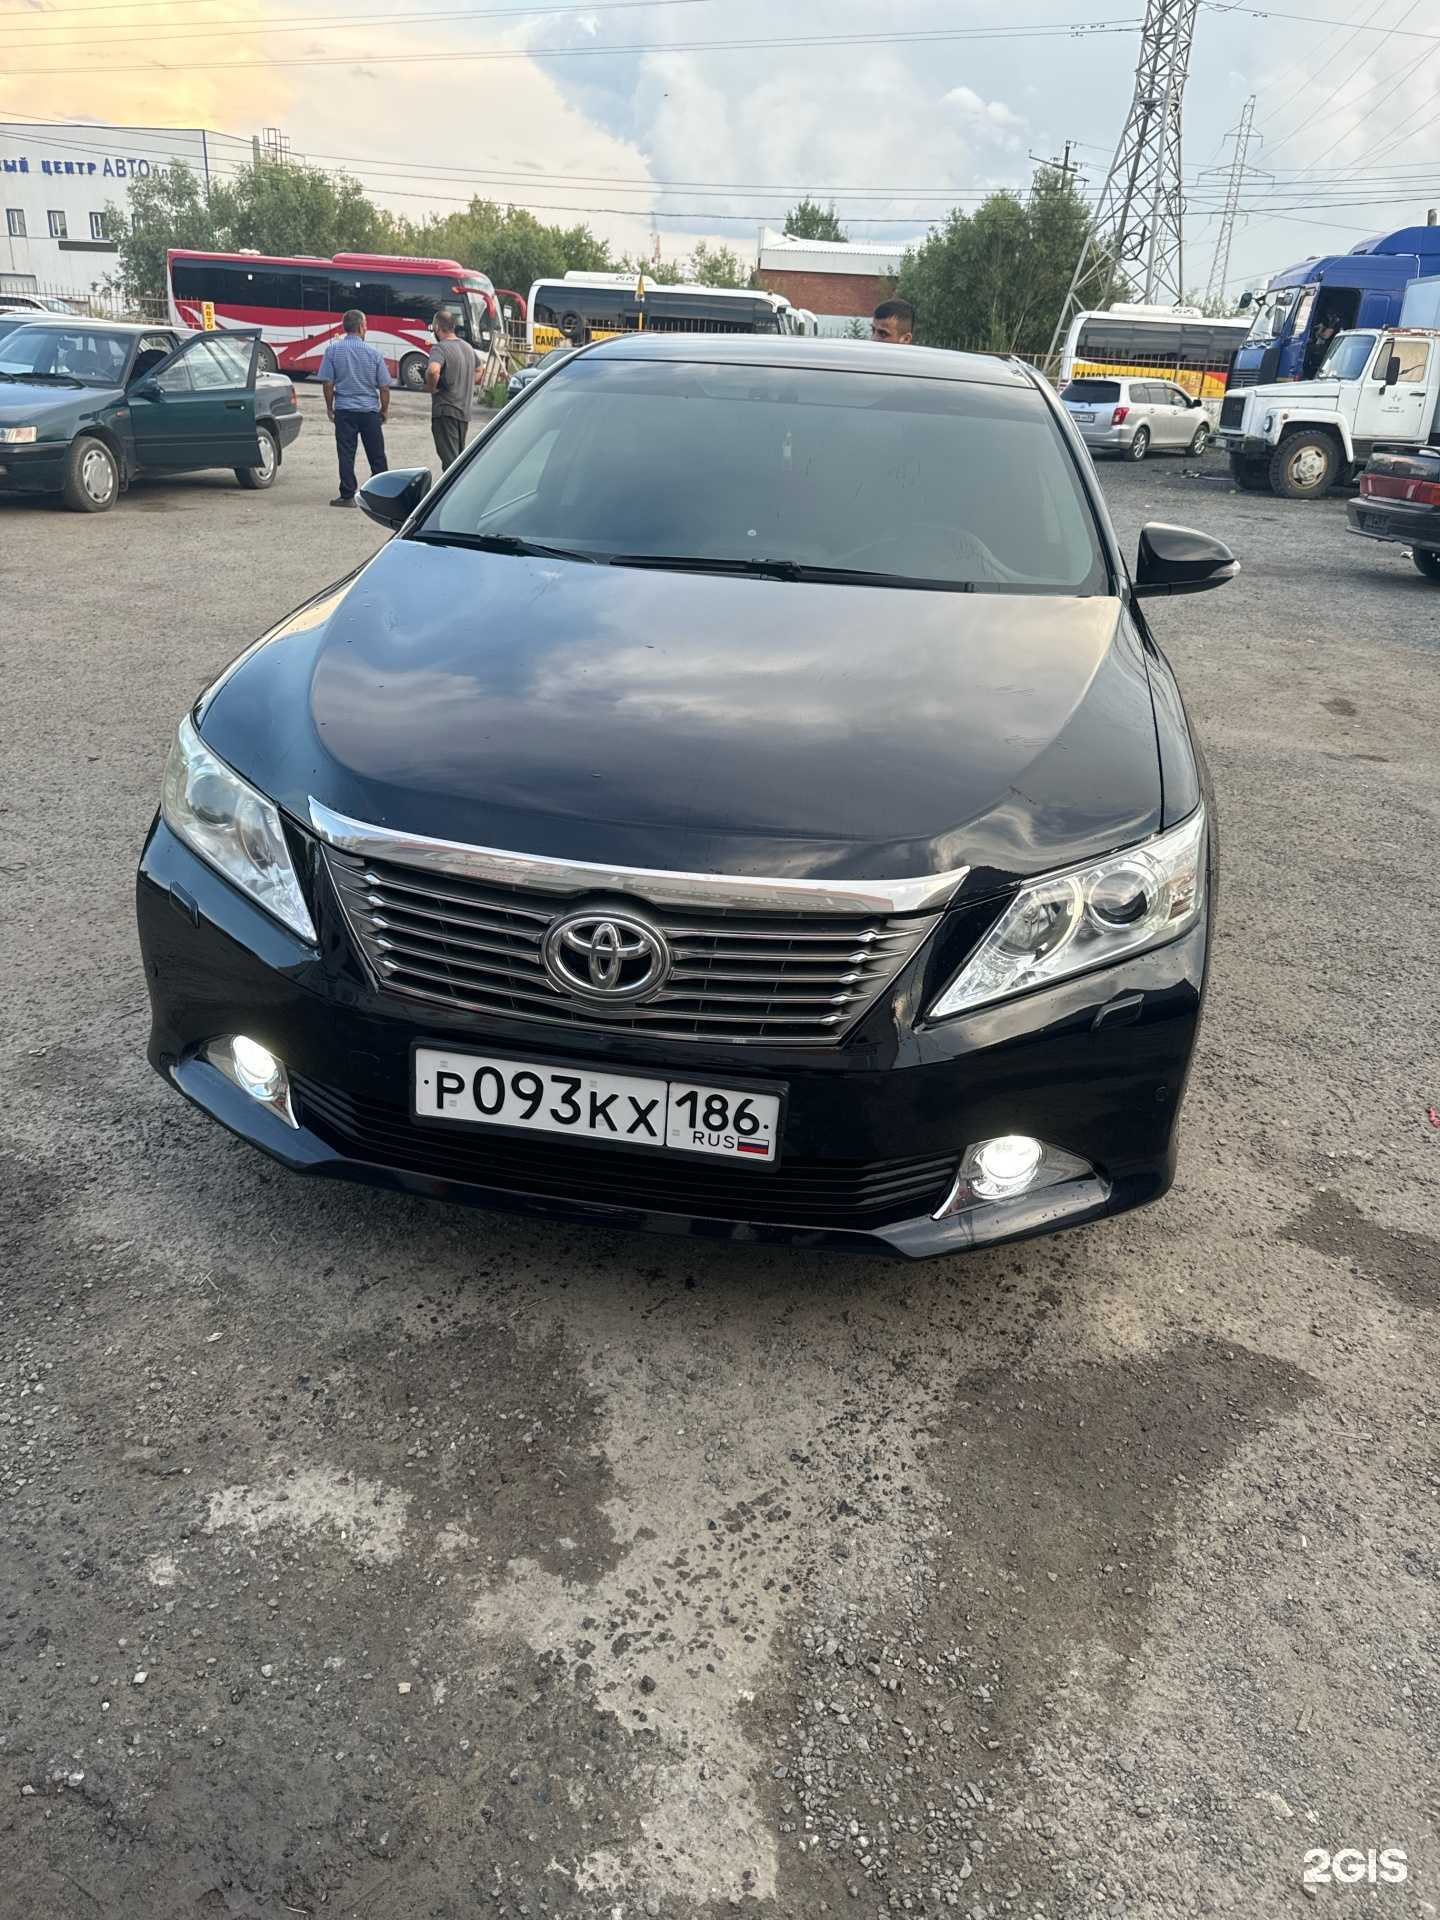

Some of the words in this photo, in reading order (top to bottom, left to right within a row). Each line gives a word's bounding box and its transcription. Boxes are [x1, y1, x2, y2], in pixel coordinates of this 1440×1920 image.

[0, 156, 29, 173] ЫЙ
[41, 159, 97, 176] ЦЕНТР
[674, 1090, 760, 1136] 186
[692, 1130, 735, 1149] RUS
